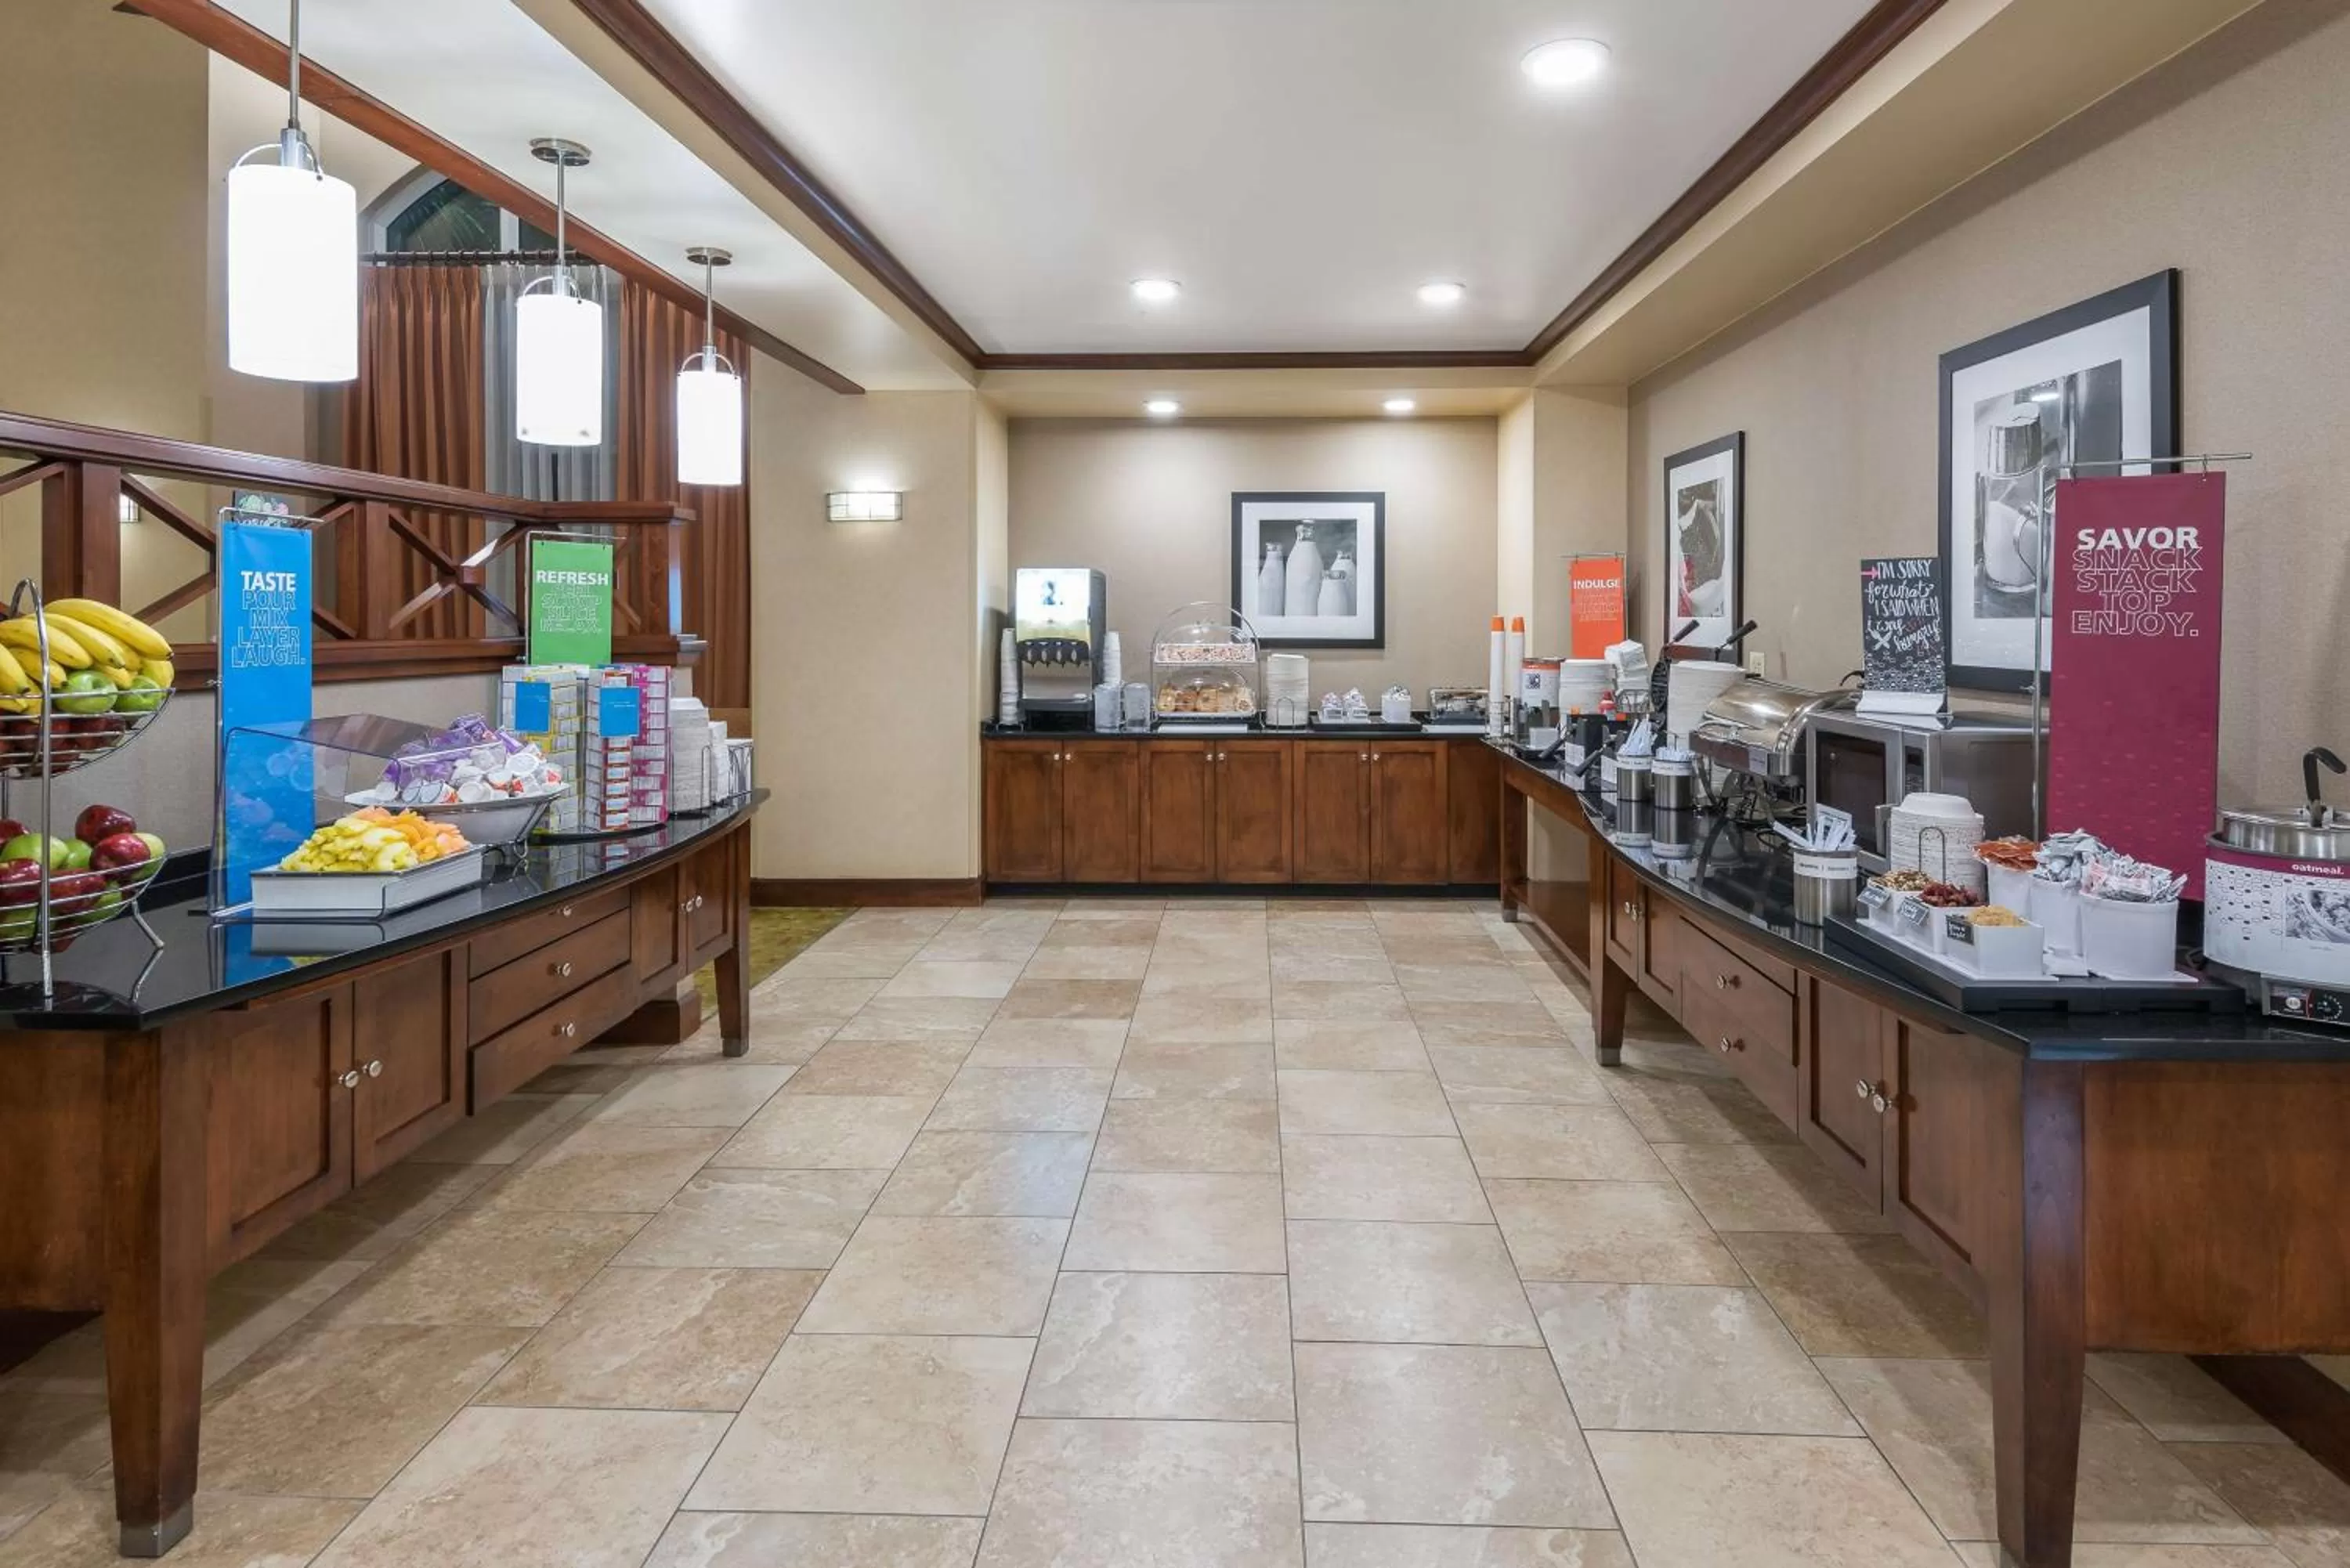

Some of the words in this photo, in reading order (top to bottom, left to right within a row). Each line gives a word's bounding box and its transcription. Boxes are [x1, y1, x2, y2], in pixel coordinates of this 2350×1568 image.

[2077, 526, 2199, 549] SAVOR
[2072, 547, 2203, 571] SNACK
[240, 570, 296, 591] TASTE
[536, 569, 609, 586] REFRESH
[2077, 569, 2196, 592] STACK
[241, 589, 297, 610] POUR
[2099, 590, 2171, 614] TOP
[2072, 610, 2199, 637] ENJOY.
[238, 626, 300, 649] LAYER
[231, 645, 306, 668] LAUGH.
[2291, 863, 2345, 876] oatmeal.
